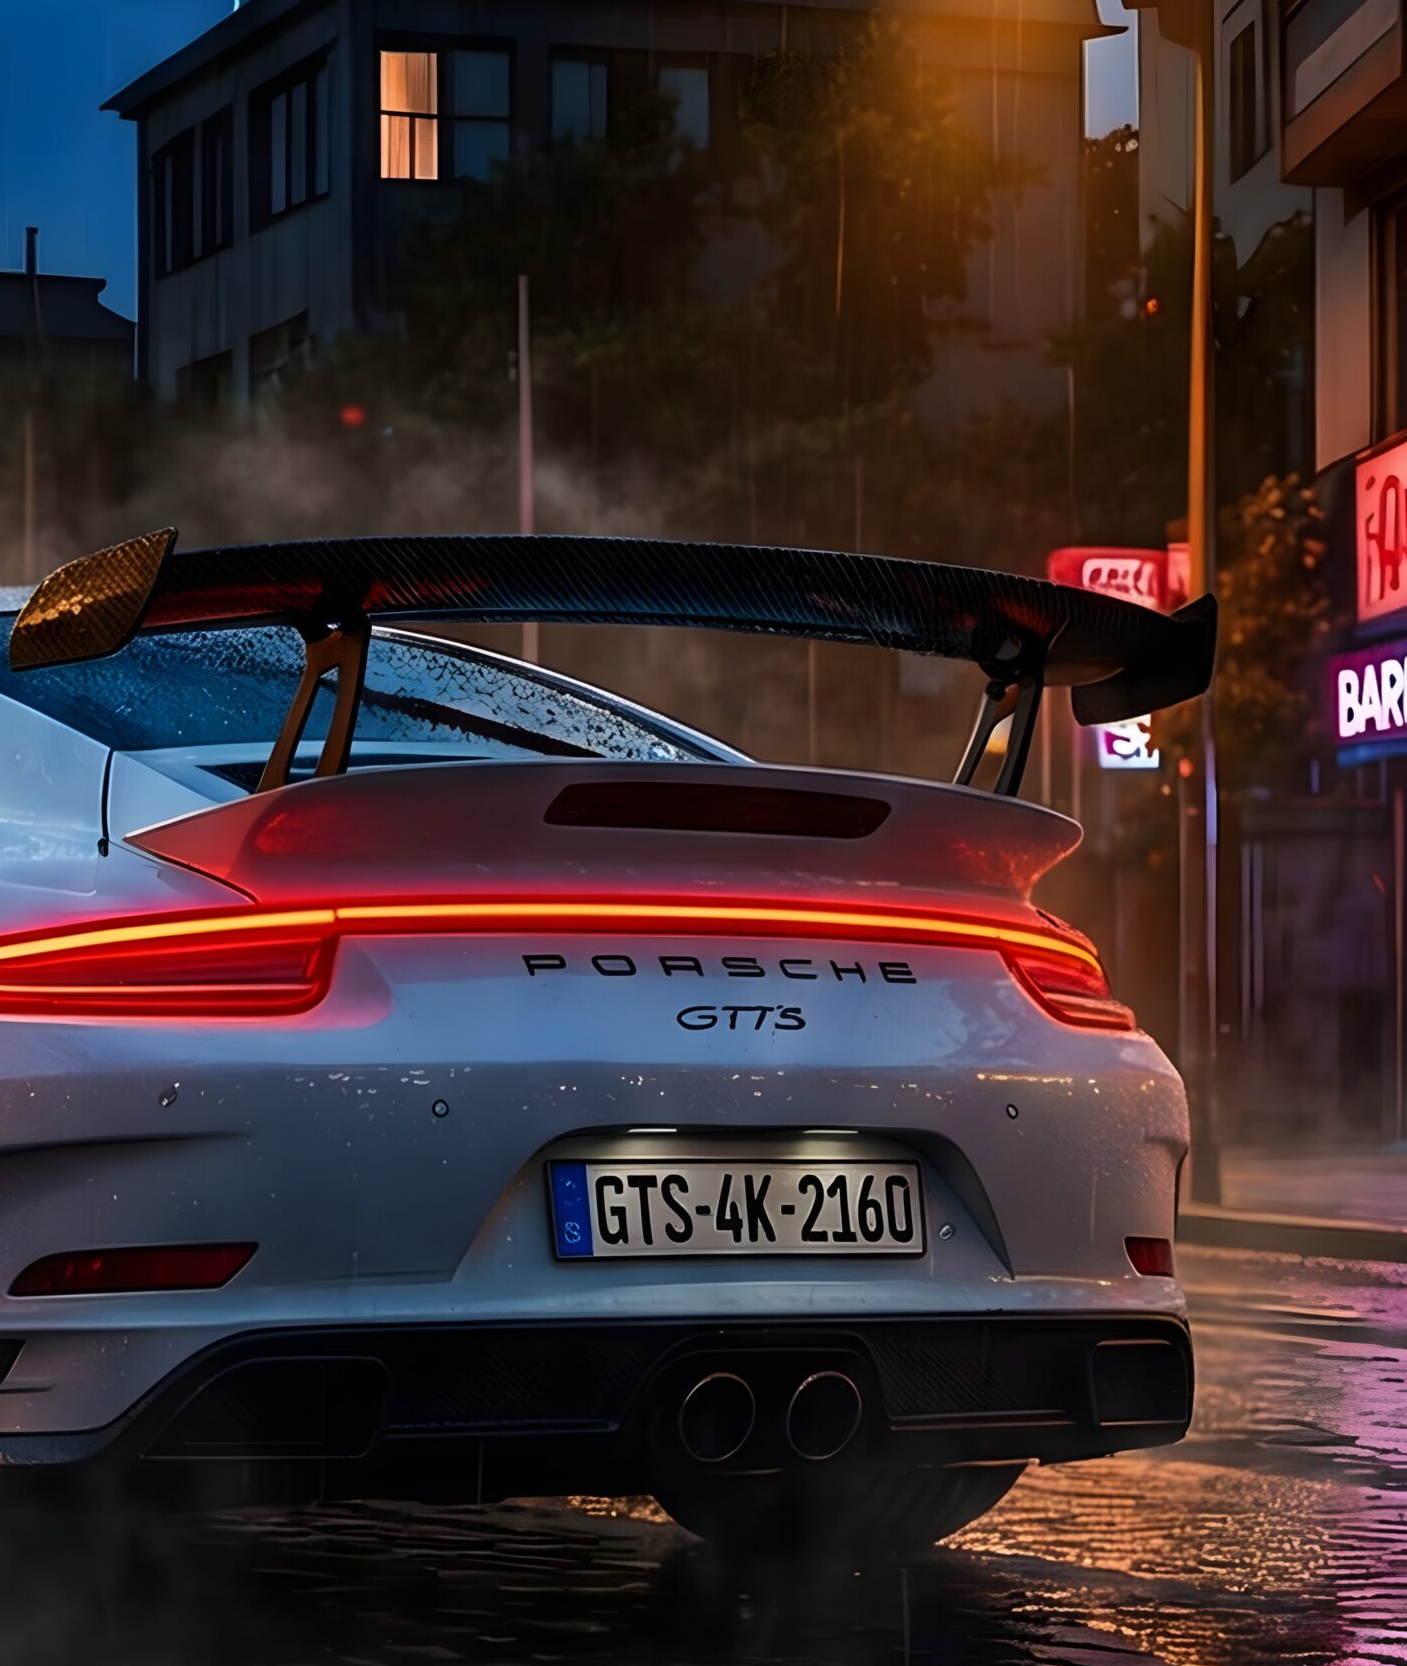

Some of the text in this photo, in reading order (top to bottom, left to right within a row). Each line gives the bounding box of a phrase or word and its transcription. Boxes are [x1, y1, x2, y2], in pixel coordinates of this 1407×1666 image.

[1337, 655, 1407, 738] BAR
[521, 954, 918, 984] PORSCHE
[594, 1173, 915, 1246] GTS-4K-2160
